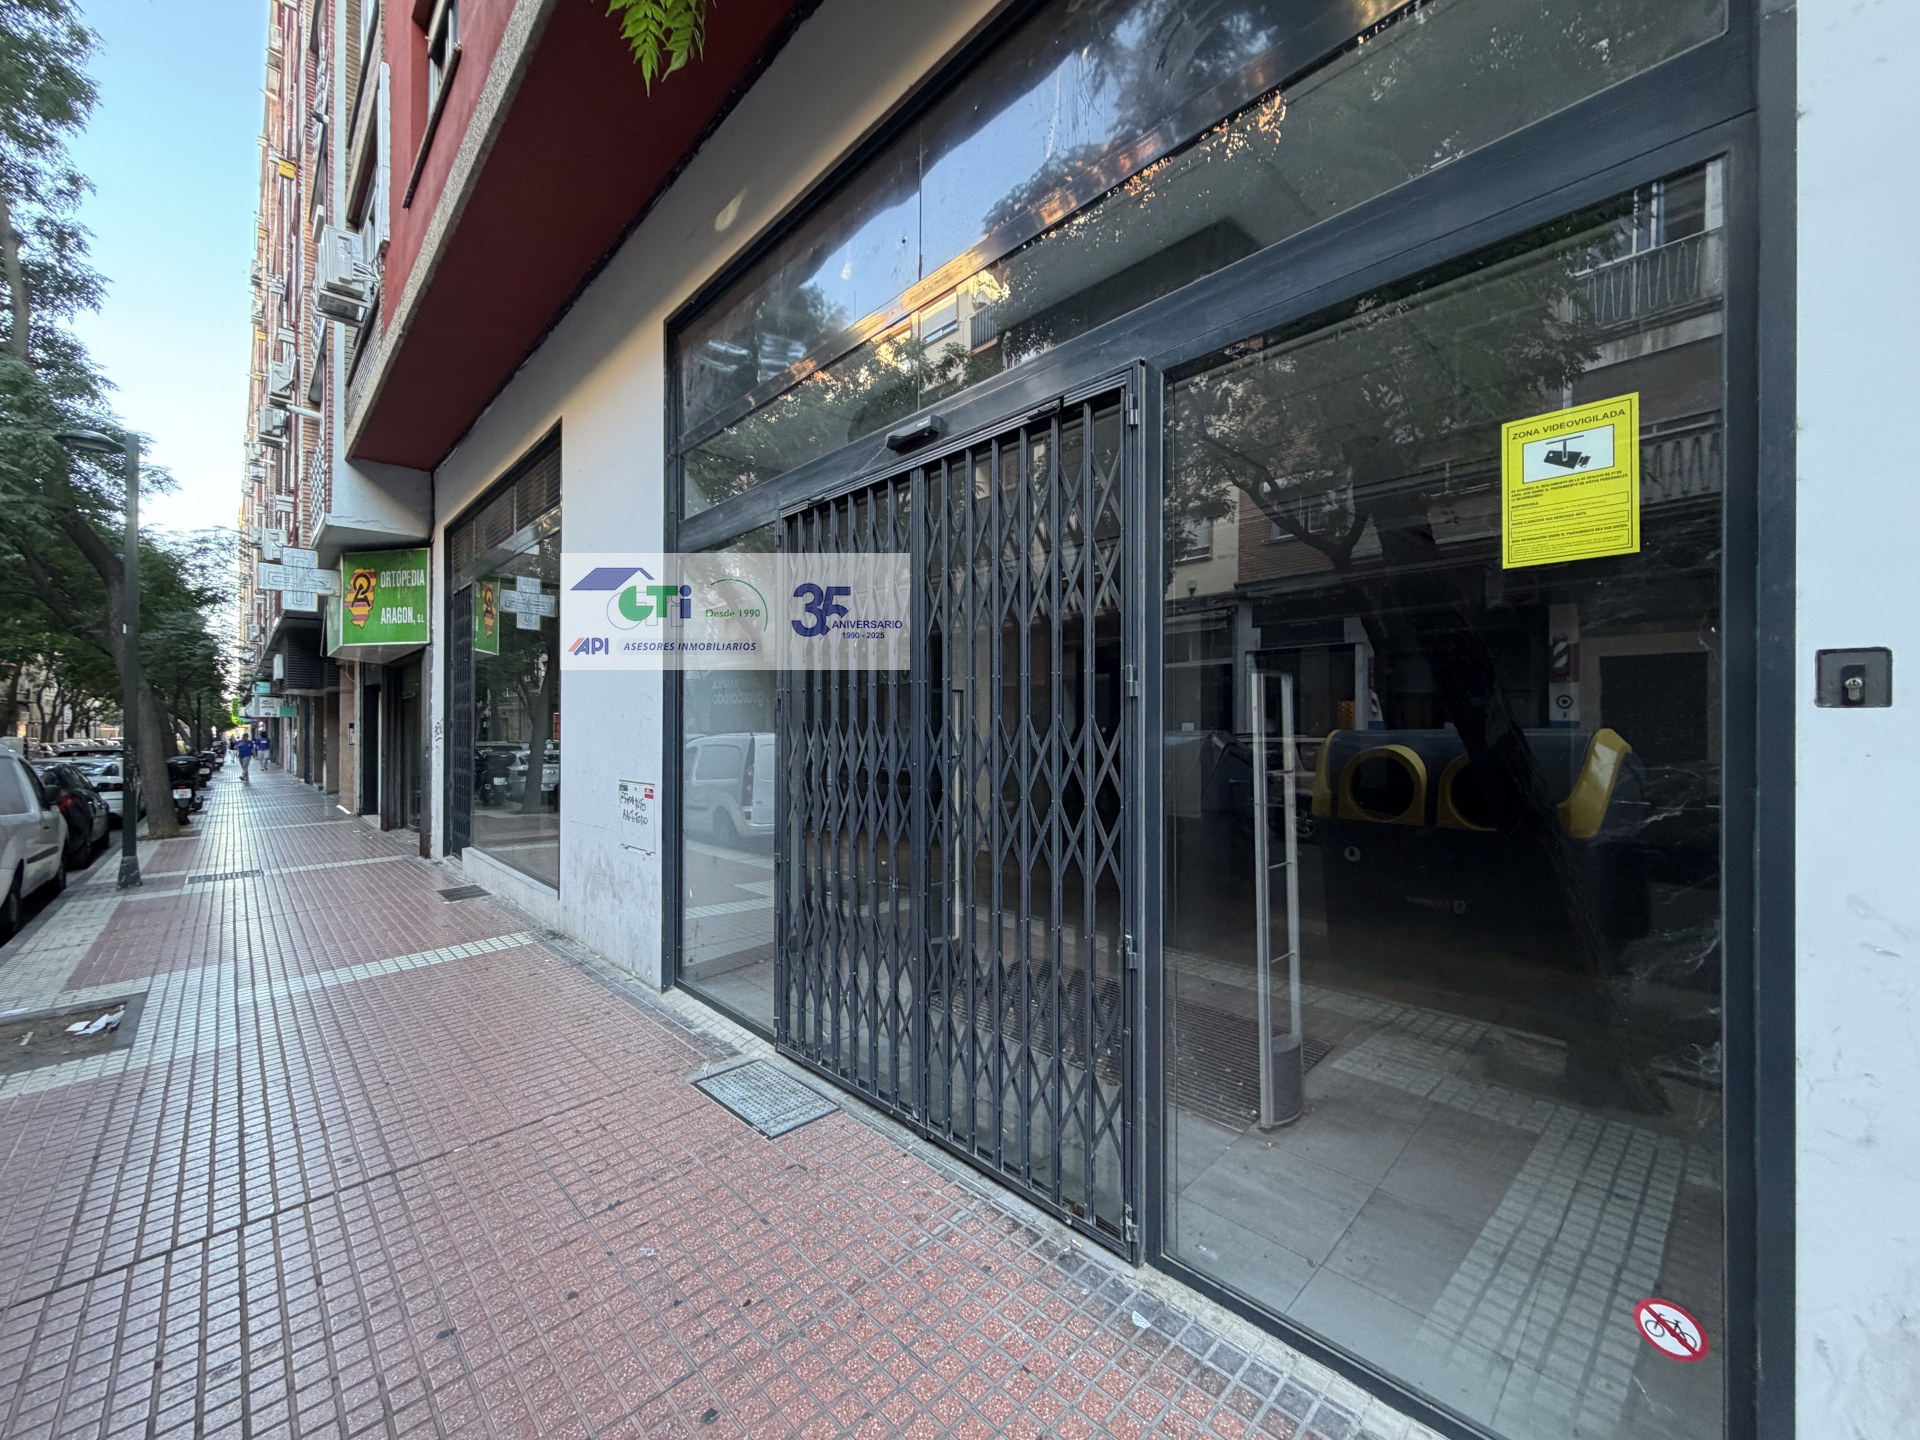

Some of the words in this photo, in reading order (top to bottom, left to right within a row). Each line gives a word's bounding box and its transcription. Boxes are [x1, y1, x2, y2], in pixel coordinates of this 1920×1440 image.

[1512, 428, 1540, 440] ZONA
[1542, 408, 1626, 433] VIDEOVIGILADA
[381, 570, 425, 588] ORTOPEDIA
[381, 607, 415, 625] ARAGON,
